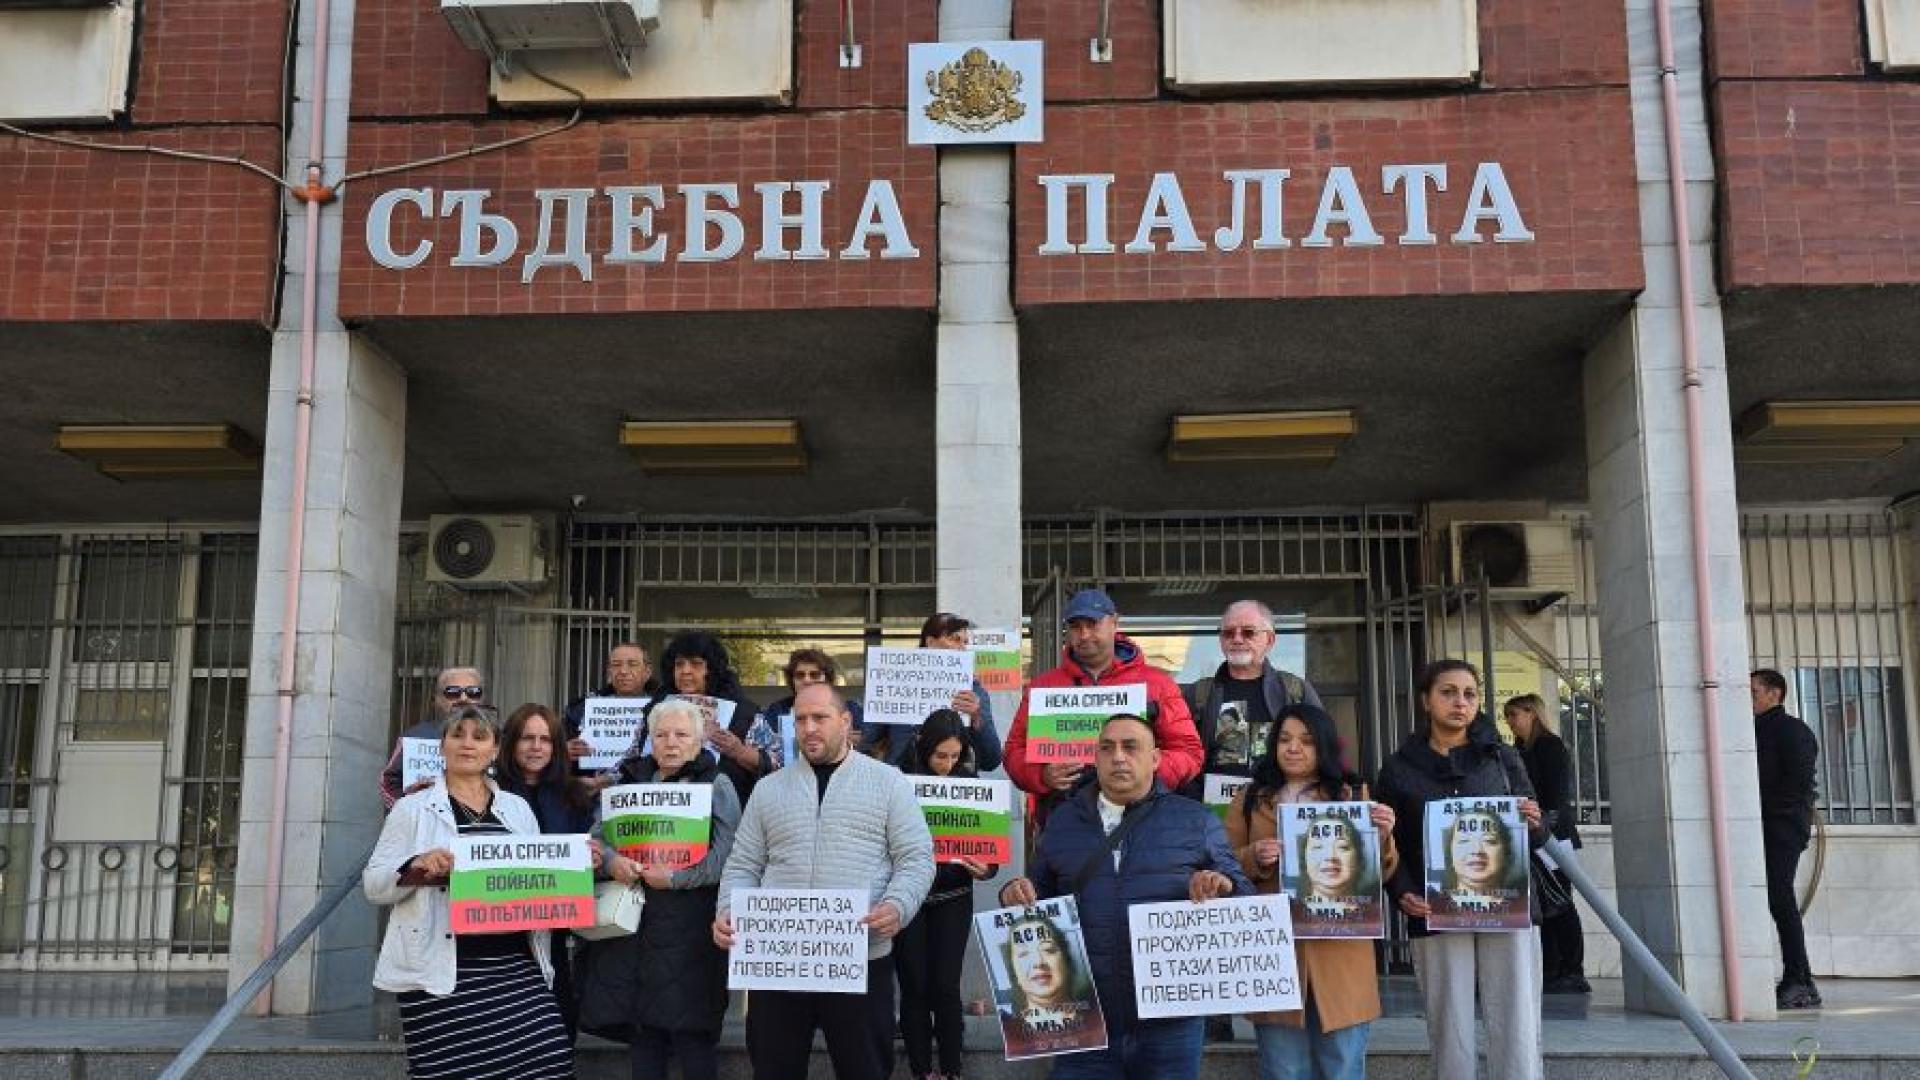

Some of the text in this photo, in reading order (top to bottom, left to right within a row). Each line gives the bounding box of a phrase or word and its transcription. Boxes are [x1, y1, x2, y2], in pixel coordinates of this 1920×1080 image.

[365, 162, 1536, 283] СЪДЕБНА ПАЛАТА
[880, 652, 944, 667] ПОДКРЕПА
[946, 655, 962, 667] ЗА
[869, 668, 969, 685] ПРОКУРАТУРАТА
[876, 685, 884, 697] В
[886, 686, 918, 700] ТАЗИ
[1045, 692, 1128, 708] НЕКА СПРЕМ
[867, 701, 916, 715] ПЛЕВЕН
[918, 702, 928, 715] Е
[1056, 717, 1100, 733] ВОЙНА
[1037, 742, 1097, 757] ПО ПЪТИ
[610, 790, 692, 810] НЕКА СПРЕМ
[914, 783, 993, 801] НЕКА СПРЕМ
[1297, 805, 1362, 820] АЗ СЪМ
[1443, 800, 1511, 814] АЗ СЪМ
[617, 819, 676, 837] ВОЙНАТА
[925, 809, 981, 828] ВОЙНАТА
[470, 842, 571, 861] НЕКА СПРЕМ
[486, 871, 557, 892] ВОЙНАТА
[465, 902, 577, 924] ПО ПЪТИЩАТА
[747, 895, 854, 916] ПОДКРЕПА ЗА
[736, 916, 865, 935] ПРОКУРАТУРАТА
[994, 903, 1061, 929] АЗ СЪМ
[1148, 905, 1272, 930] ПОДКРЕПА ЗА
[745, 938, 854, 957] В ТАЗИ БИТКА!
[1137, 927, 1289, 954] ПРОКУРАТУРАТА
[733, 959, 865, 980] ПЛЕВЕН Е С ВАС!
[1150, 953, 1280, 978] В ТАЗИ БИТКА!
[1141, 976, 1295, 1004] ПЛЕВЕН Е С ВАС!
